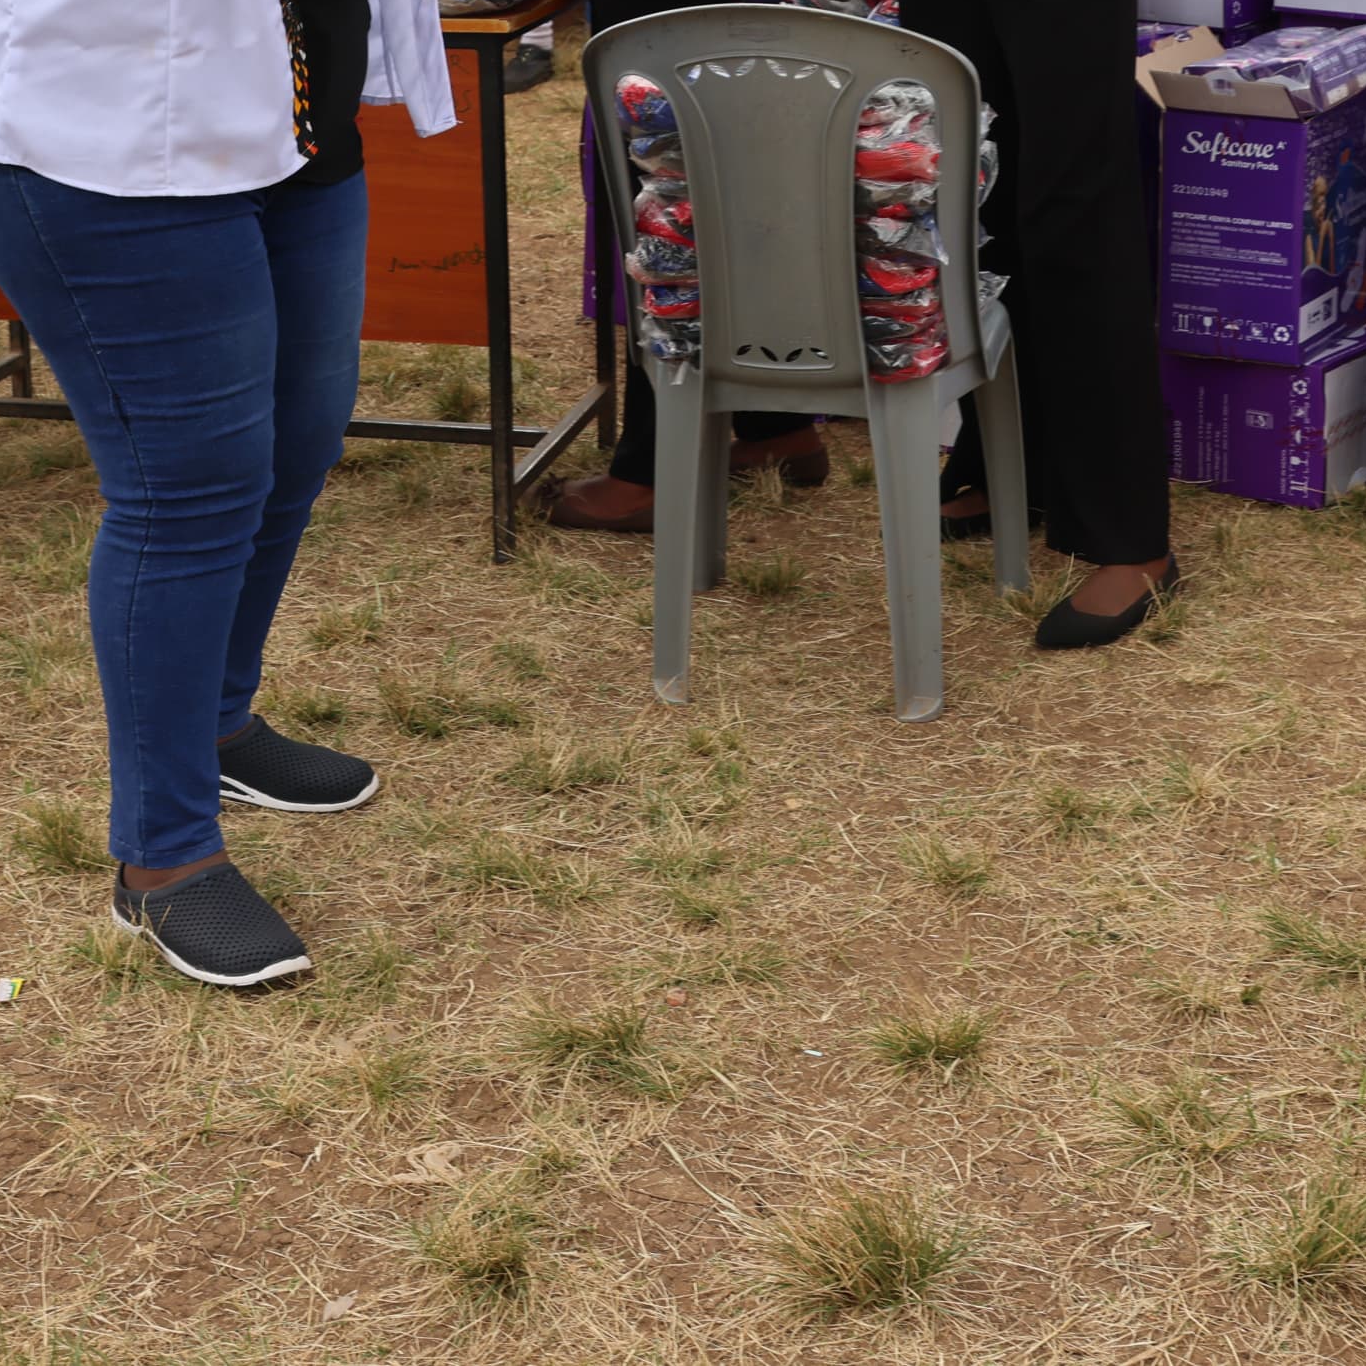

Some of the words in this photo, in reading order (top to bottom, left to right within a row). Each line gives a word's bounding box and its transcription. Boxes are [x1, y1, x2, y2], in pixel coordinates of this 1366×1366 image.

[1181, 130, 1275, 163] Softcare
[1221, 158, 1256, 170] Sanitary
[1256, 161, 1279, 171] Pads
